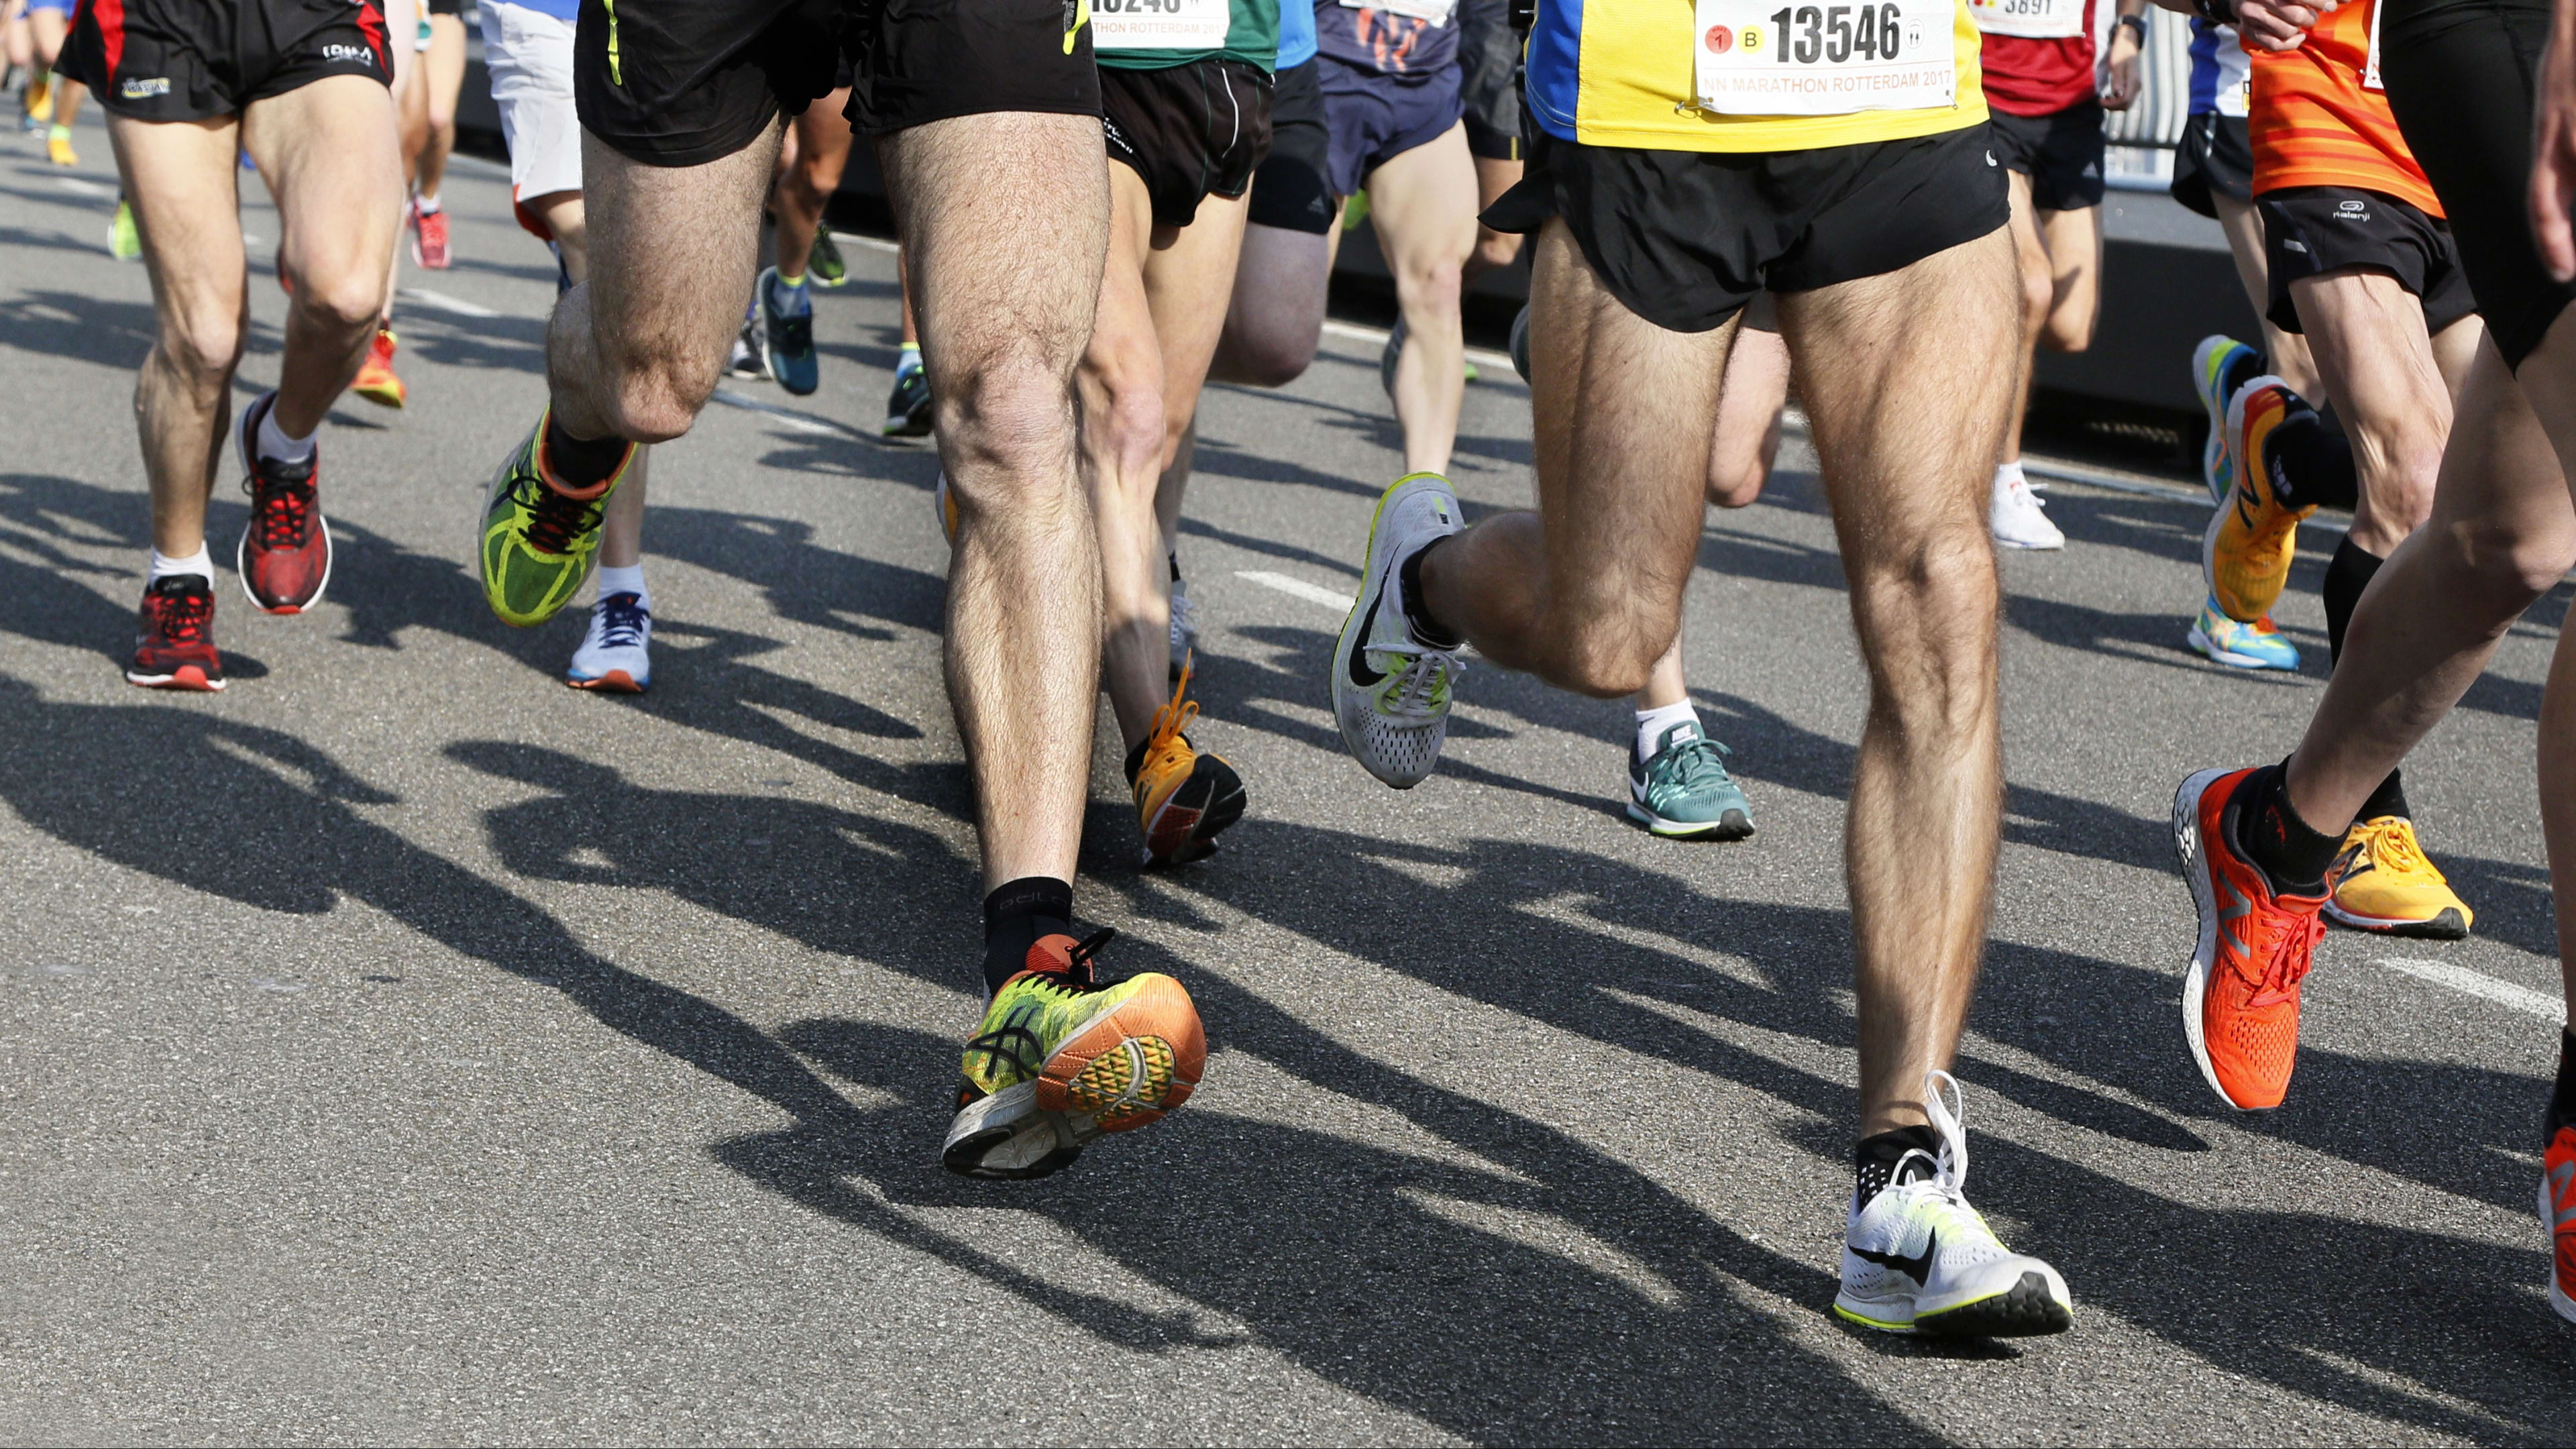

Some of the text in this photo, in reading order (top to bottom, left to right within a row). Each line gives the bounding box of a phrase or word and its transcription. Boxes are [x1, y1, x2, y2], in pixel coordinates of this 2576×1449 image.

[1094, 22, 1126, 33] THON
[1130, 23, 1199, 34] ROTTERDAM
[1715, 2, 1901, 64] 1 B 13546
[1704, 69, 1951, 93] NN MARATHON ROTTERDAM 2017
[1672, 724, 1692, 742] NIKE
